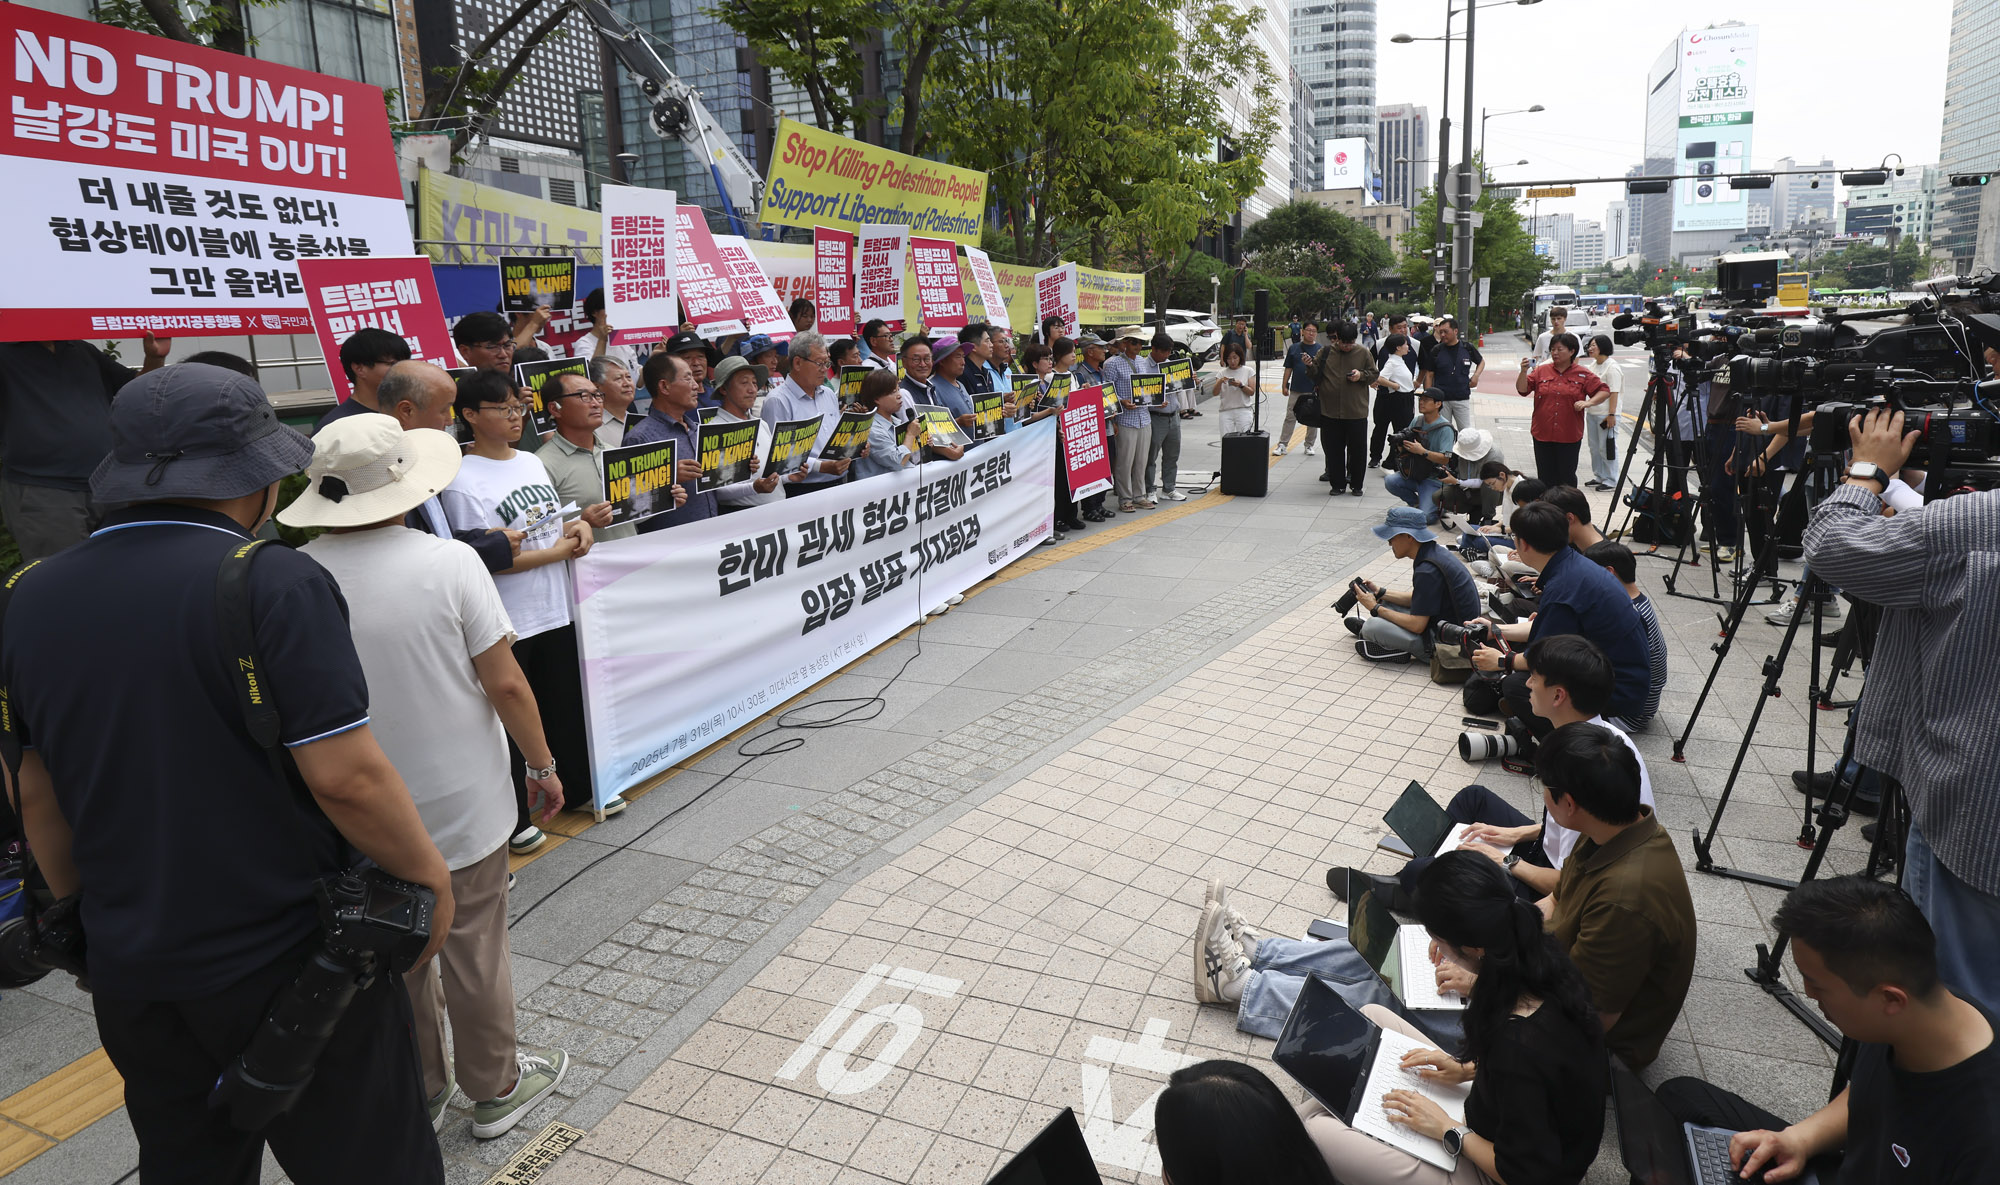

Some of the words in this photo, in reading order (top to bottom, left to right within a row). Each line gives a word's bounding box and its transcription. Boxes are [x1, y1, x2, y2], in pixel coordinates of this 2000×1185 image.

[15, 28, 118, 96] NO
[135, 53, 344, 137] TRUMP!
[1687, 89, 1710, 102] 가전
[1711, 85, 1748, 101] 페스타
[1712, 114, 1726, 122] 10%
[11, 95, 157, 155] 날강도
[170, 120, 249, 167] 미국
[259, 135, 346, 180] OUT!
[782, 132, 827, 178] Stop
[826, 146, 880, 190] Killing
[877, 159, 946, 197] Palestinian
[945, 174, 983, 207] People!
[1334, 166, 1348, 176] LG
[78, 177, 118, 211] 더
[126, 181, 197, 217] 내줄
[204, 189, 268, 221] 것도
[272, 196, 339, 228] 없다!
[768, 177, 841, 220] Support
[839, 192, 912, 225] Liberation
[912, 206, 930, 231] of
[926, 208, 982, 236] Palestine!
[611, 216, 665, 236] 트럼프는
[49, 216, 261, 260] 협상테이블에
[268, 231, 371, 262] 농축산물
[611, 237, 665, 258] 내정간섭
[863, 236, 901, 253] 트럼프에
[818, 240, 846, 256] 트럼프의
[914, 247, 951, 262] 트럼프의
[735, 262, 762, 276] 일자리
[818, 256, 846, 273] 내정간섭
[862, 252, 889, 269] 맞서서
[916, 262, 933, 275] 경제
[933, 262, 957, 275] 일자리
[506, 265, 525, 279] NO
[530, 262, 572, 278] TRUMP!
[612, 258, 665, 281] 주권침해
[861, 267, 892, 281] 식량주권
[149, 266, 216, 298] 그만
[507, 278, 530, 296] NO
[536, 275, 571, 294] KING!
[750, 275, 769, 289] 안보
[818, 274, 847, 289] 막아내고
[861, 279, 899, 294] 국민생존권
[918, 275, 942, 288] 먹거리
[942, 274, 959, 287] 안보
[997, 269, 1014, 286] the
[1014, 272, 1036, 288] sea!
[1038, 271, 1067, 291] 트럼프의
[319, 278, 422, 314] 트럼프에
[613, 280, 670, 303] 중단하라!
[680, 277, 733, 299] 국민주권을
[920, 288, 949, 303] 위협을
[1040, 286, 1061, 303] 부당한
[819, 290, 840, 305] 주권을
[860, 292, 899, 310] 지켜내자!
[1040, 297, 1062, 313] 위협을
[687, 295, 733, 318] 실현하자!
[745, 304, 787, 325] 규탄한다!
[820, 306, 850, 323] 지켜내자!
[923, 302, 963, 318] 규탄한다!
[90, 314, 242, 331] 트럼프위협저지공동행동
[1784, 332, 1799, 343] SBS
[1170, 361, 1190, 372] TRUMP!
[1173, 368, 1191, 382] KING!
[529, 373, 547, 390] NO
[848, 381, 862, 395] KIN
[1132, 379, 1140, 387] NO
[1141, 377, 1163, 386] TRUMP!
[1133, 387, 1142, 397] NO
[1143, 385, 1163, 396] KING!
[975, 402, 984, 413] NO
[984, 396, 1002, 411] TRUMP!
[976, 411, 985, 426] NO
[986, 406, 1003, 422] KING!
[1064, 404, 1098, 426] 트럼프는
[838, 420, 855, 433] NO
[935, 421, 958, 434] KING!
[1066, 417, 1099, 441] 내정간섭
[703, 435, 719, 452] NO
[722, 425, 756, 447] TRUMP!
[775, 430, 792, 445] NO
[830, 433, 850, 447] NO
[1068, 431, 1101, 456] 주권침해
[701, 451, 720, 472] NO
[723, 440, 753, 466] KING!
[771, 444, 791, 463] NO
[792, 432, 818, 457] KING
[608, 463, 627, 481] NO
[630, 447, 671, 472] TRUMP!
[1070, 445, 1105, 472] 중단하라!
[609, 478, 631, 504] NO
[635, 463, 672, 496] KING!
[717, 527, 788, 597] 한미
[797, 508, 855, 568] 관세
[863, 491, 911, 544] 협상
[914, 471, 967, 526] 타결에
[970, 450, 1012, 499] 즈음한
[5, 559, 42, 589] Nikon
[801, 573, 856, 636] 입장
[861, 549, 905, 606] 발표
[910, 512, 982, 580] 기자회견
[251, 671, 262, 705] Nikon
[630, 746, 670, 776] 2025년
[671, 733, 689, 752] 7월
[690, 714, 726, 743] 31일(목)
[726, 703, 746, 721] 10시
[747, 690, 770, 710] 30분,
[769, 669, 799, 696] 미대사관
[799, 664, 808, 680] 옆
[809, 653, 830, 675] 농성장
[843, 637, 857, 654] 본사
[1, 701, 11, 732] Nikon
[1509, 764, 1523, 773] EOS
